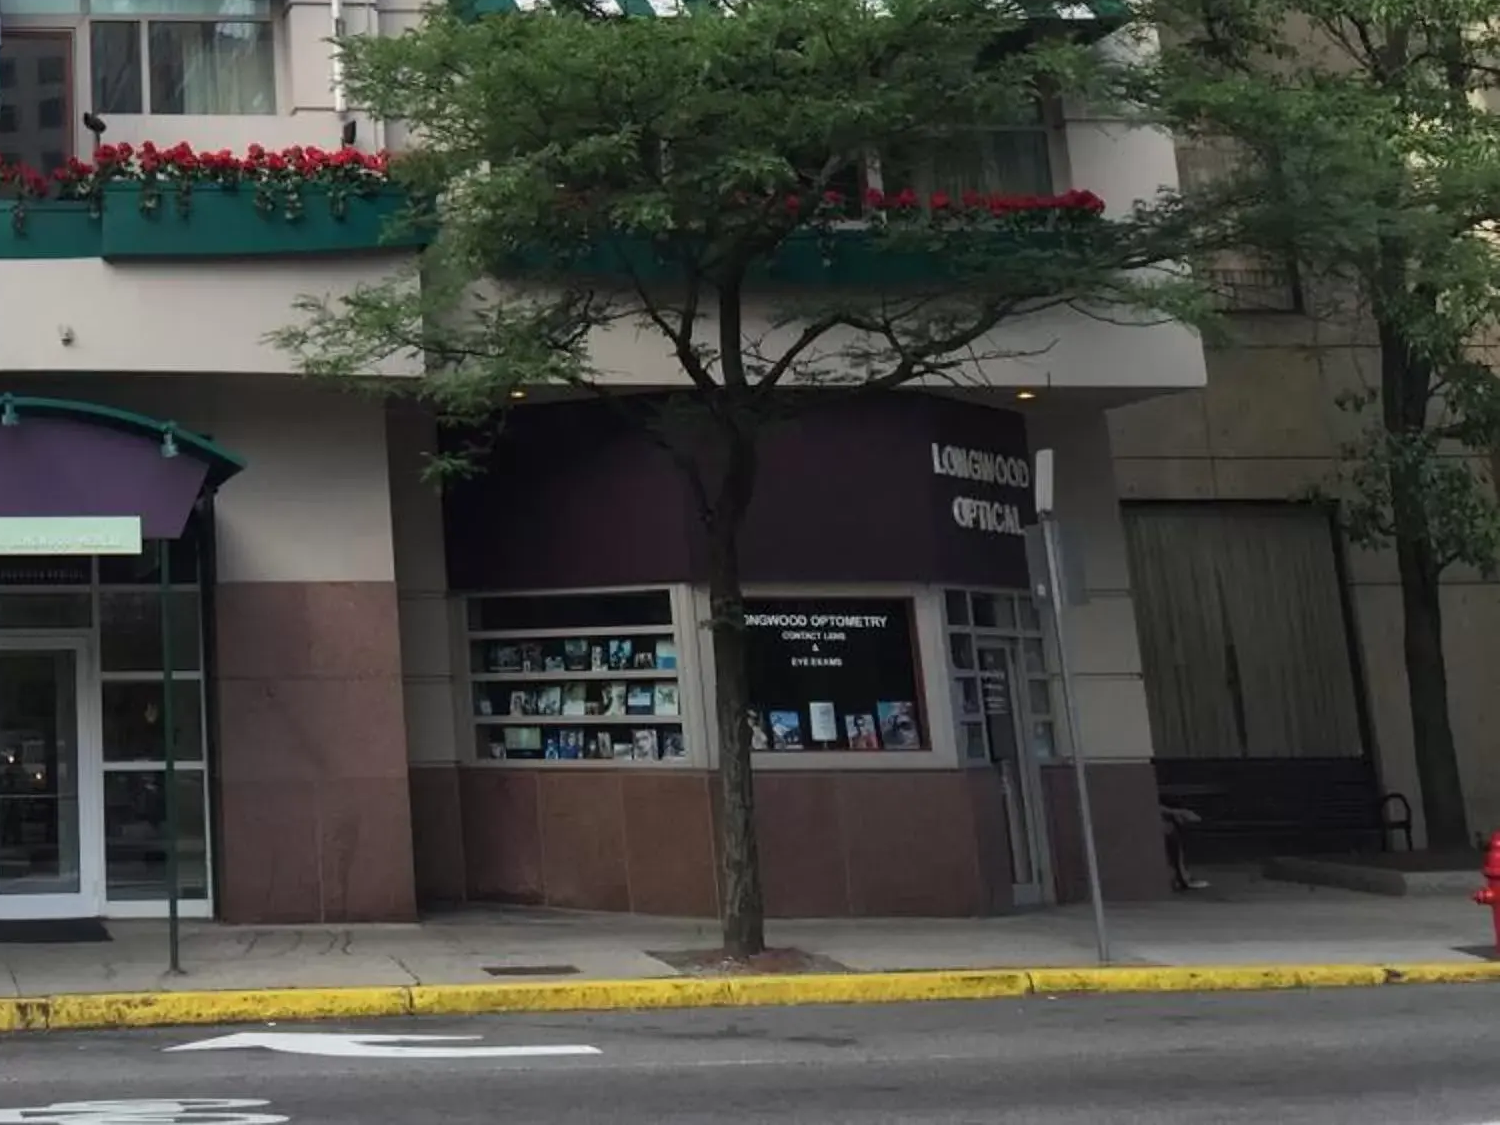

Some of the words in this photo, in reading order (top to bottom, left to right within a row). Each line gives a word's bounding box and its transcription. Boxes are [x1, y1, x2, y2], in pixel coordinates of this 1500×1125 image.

[931, 442, 1029, 487] LONGWOOD
[953, 496, 1027, 536] OPTICAL
[743, 614, 807, 626] ONGWOOD
[810, 615, 888, 628] OPTOMETRY
[781, 630, 821, 641] CONTACT
[791, 656, 808, 667] EYE
